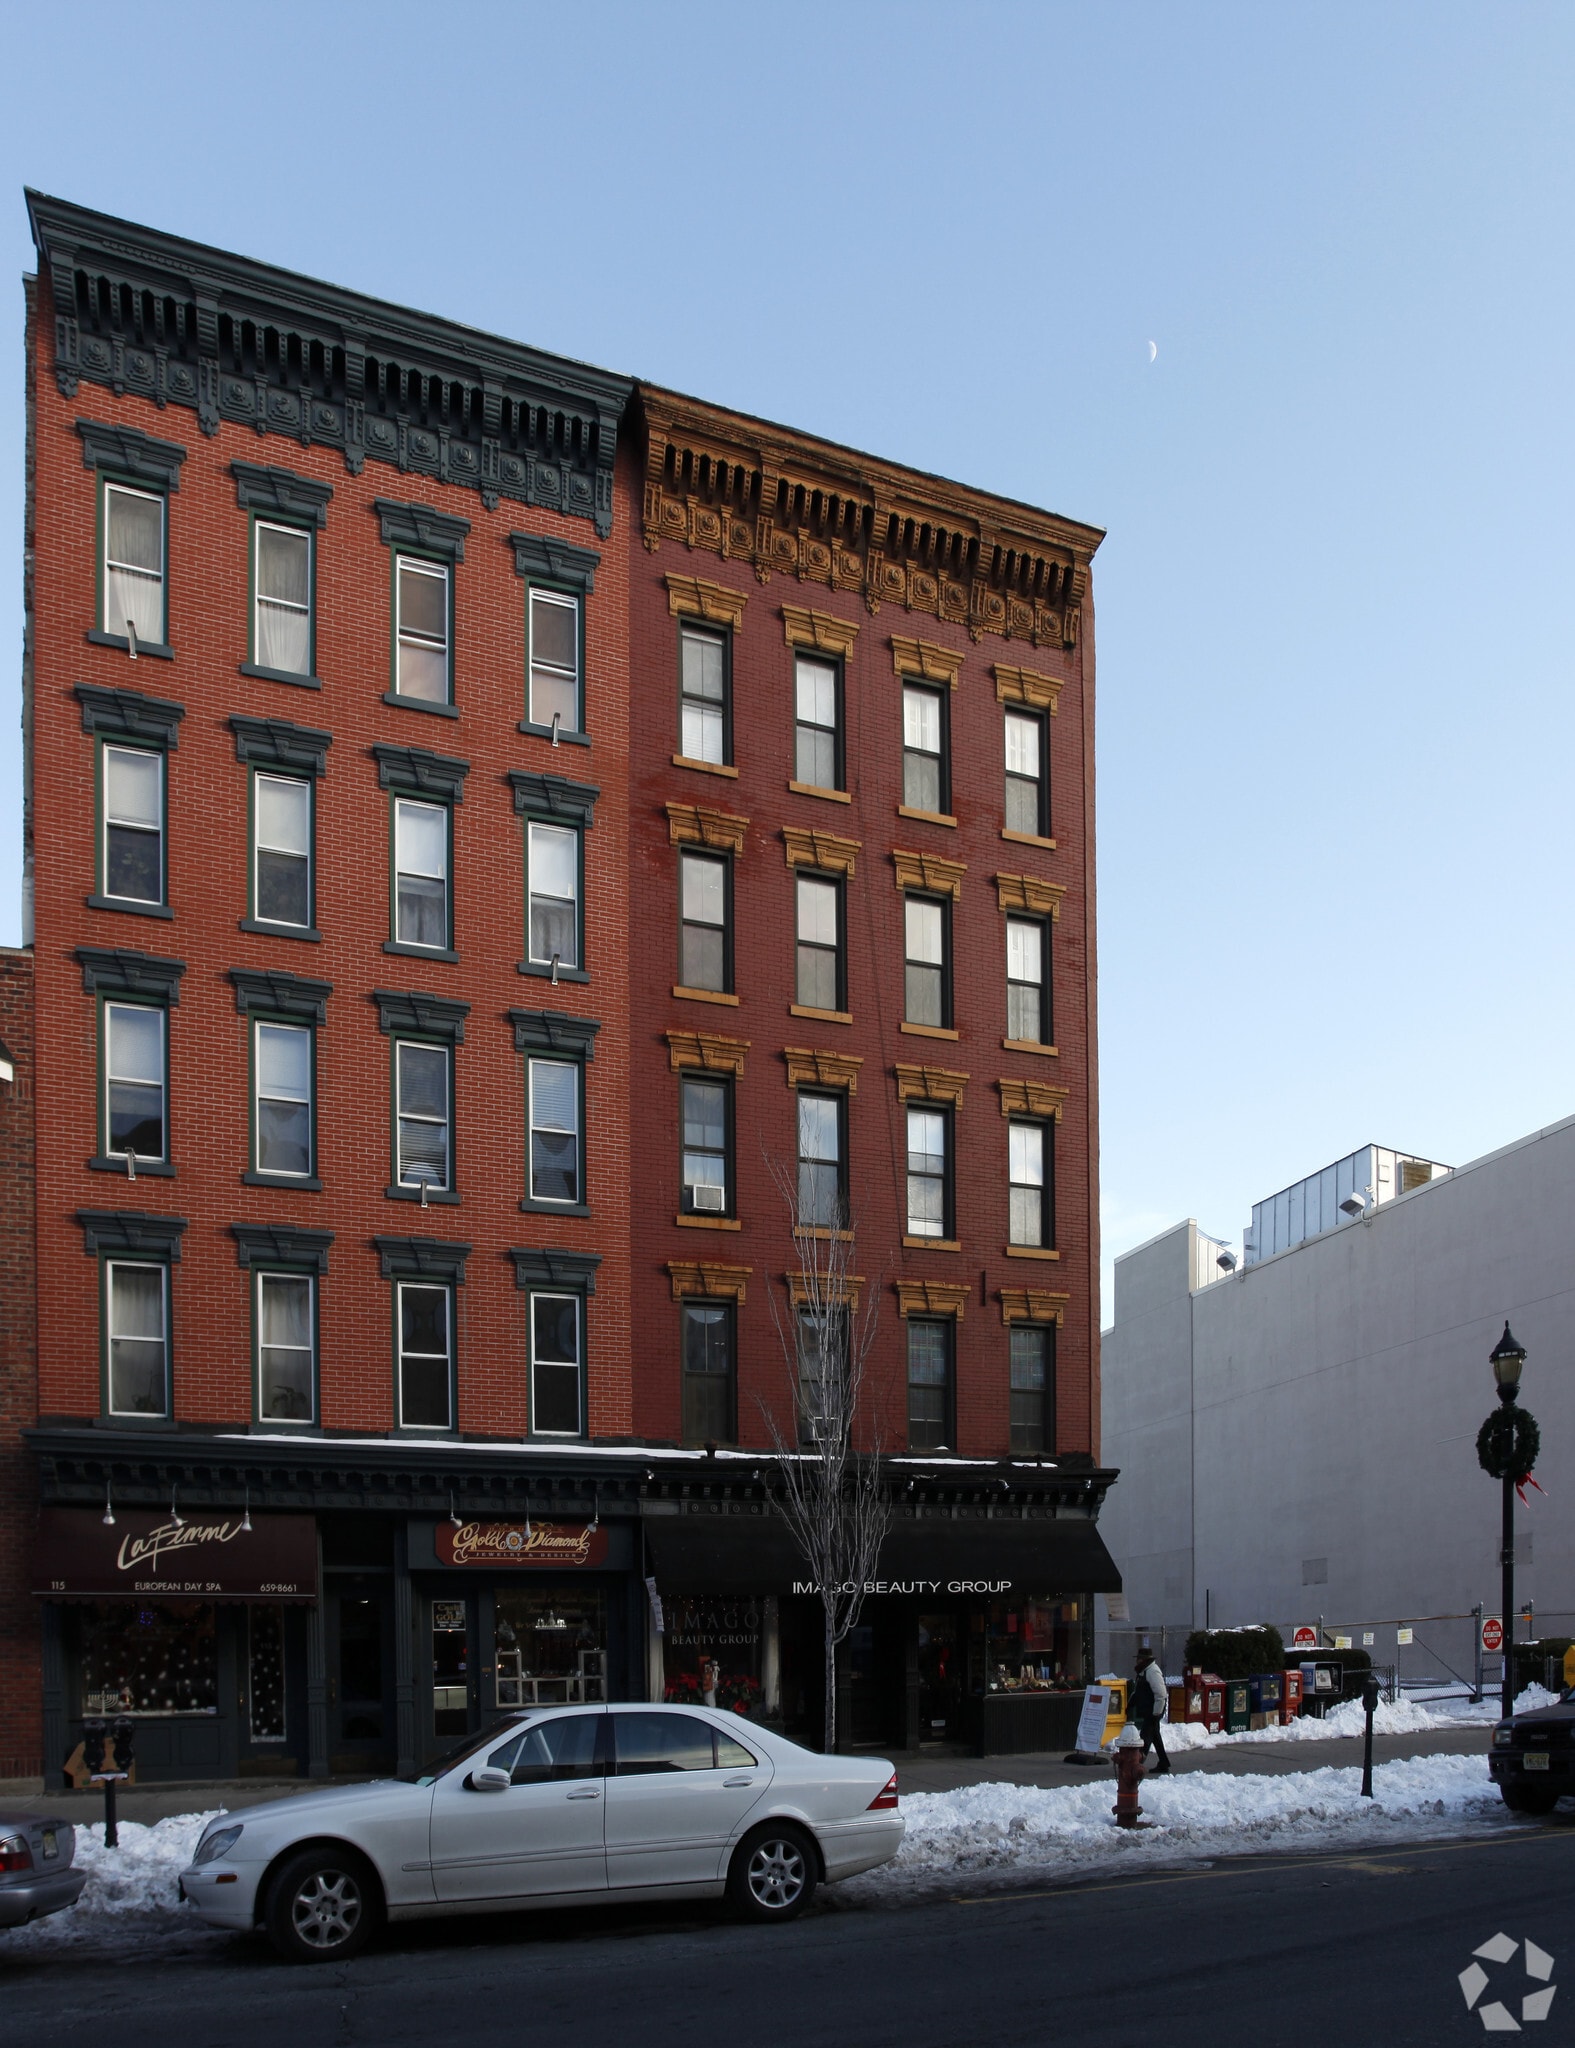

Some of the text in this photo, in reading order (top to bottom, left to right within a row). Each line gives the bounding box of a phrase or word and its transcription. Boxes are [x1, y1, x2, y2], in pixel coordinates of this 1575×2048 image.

[452, 1522, 591, 1552] Gold Diamond
[51, 1581, 66, 1591] 115
[134, 1581, 222, 1592] EUROPEAN DAY SPA
[863, 1581, 941, 1593] BEAUTY
[947, 1581, 1012, 1593] GROUP
[671, 1611, 760, 1630] IMAGO
[671, 1634, 760, 1645] BEAUTY GROUP
